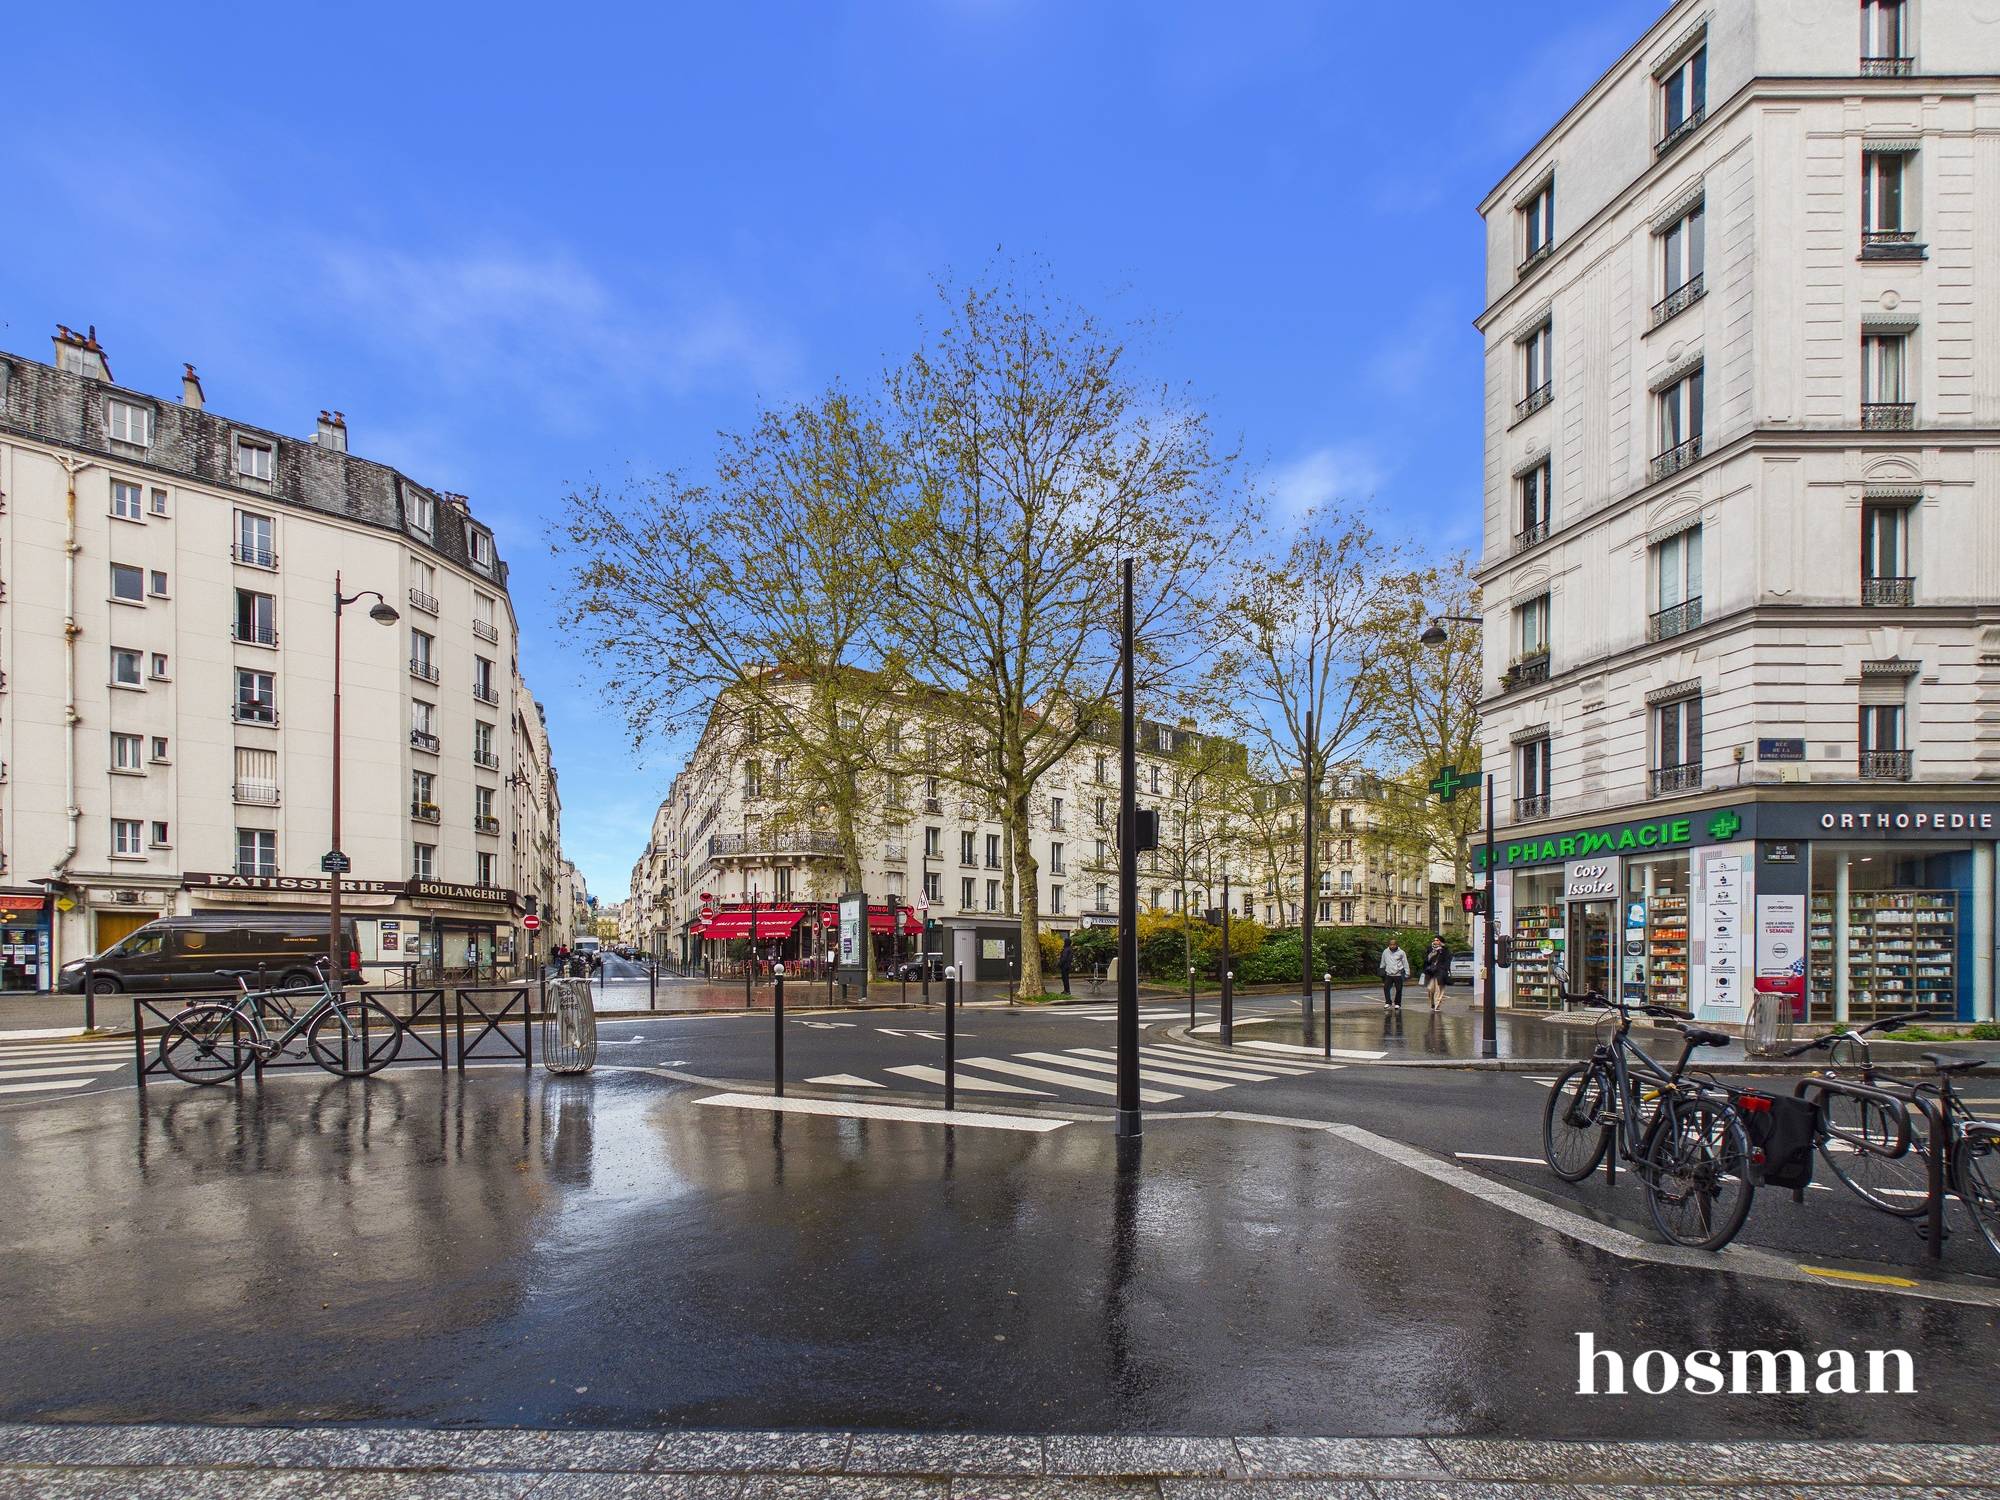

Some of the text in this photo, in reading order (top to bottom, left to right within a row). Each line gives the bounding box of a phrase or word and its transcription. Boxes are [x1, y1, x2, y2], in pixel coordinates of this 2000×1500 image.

[1821, 813, 1993, 829] ORTHOPEDIE
[1507, 819, 1690, 864] PHARMACIE
[1573, 863, 1607, 881] Coty
[209, 874, 385, 892] PATISSERIE
[420, 883, 507, 901] BOULANGERIE
[1567, 879, 1614, 896] Issoire
